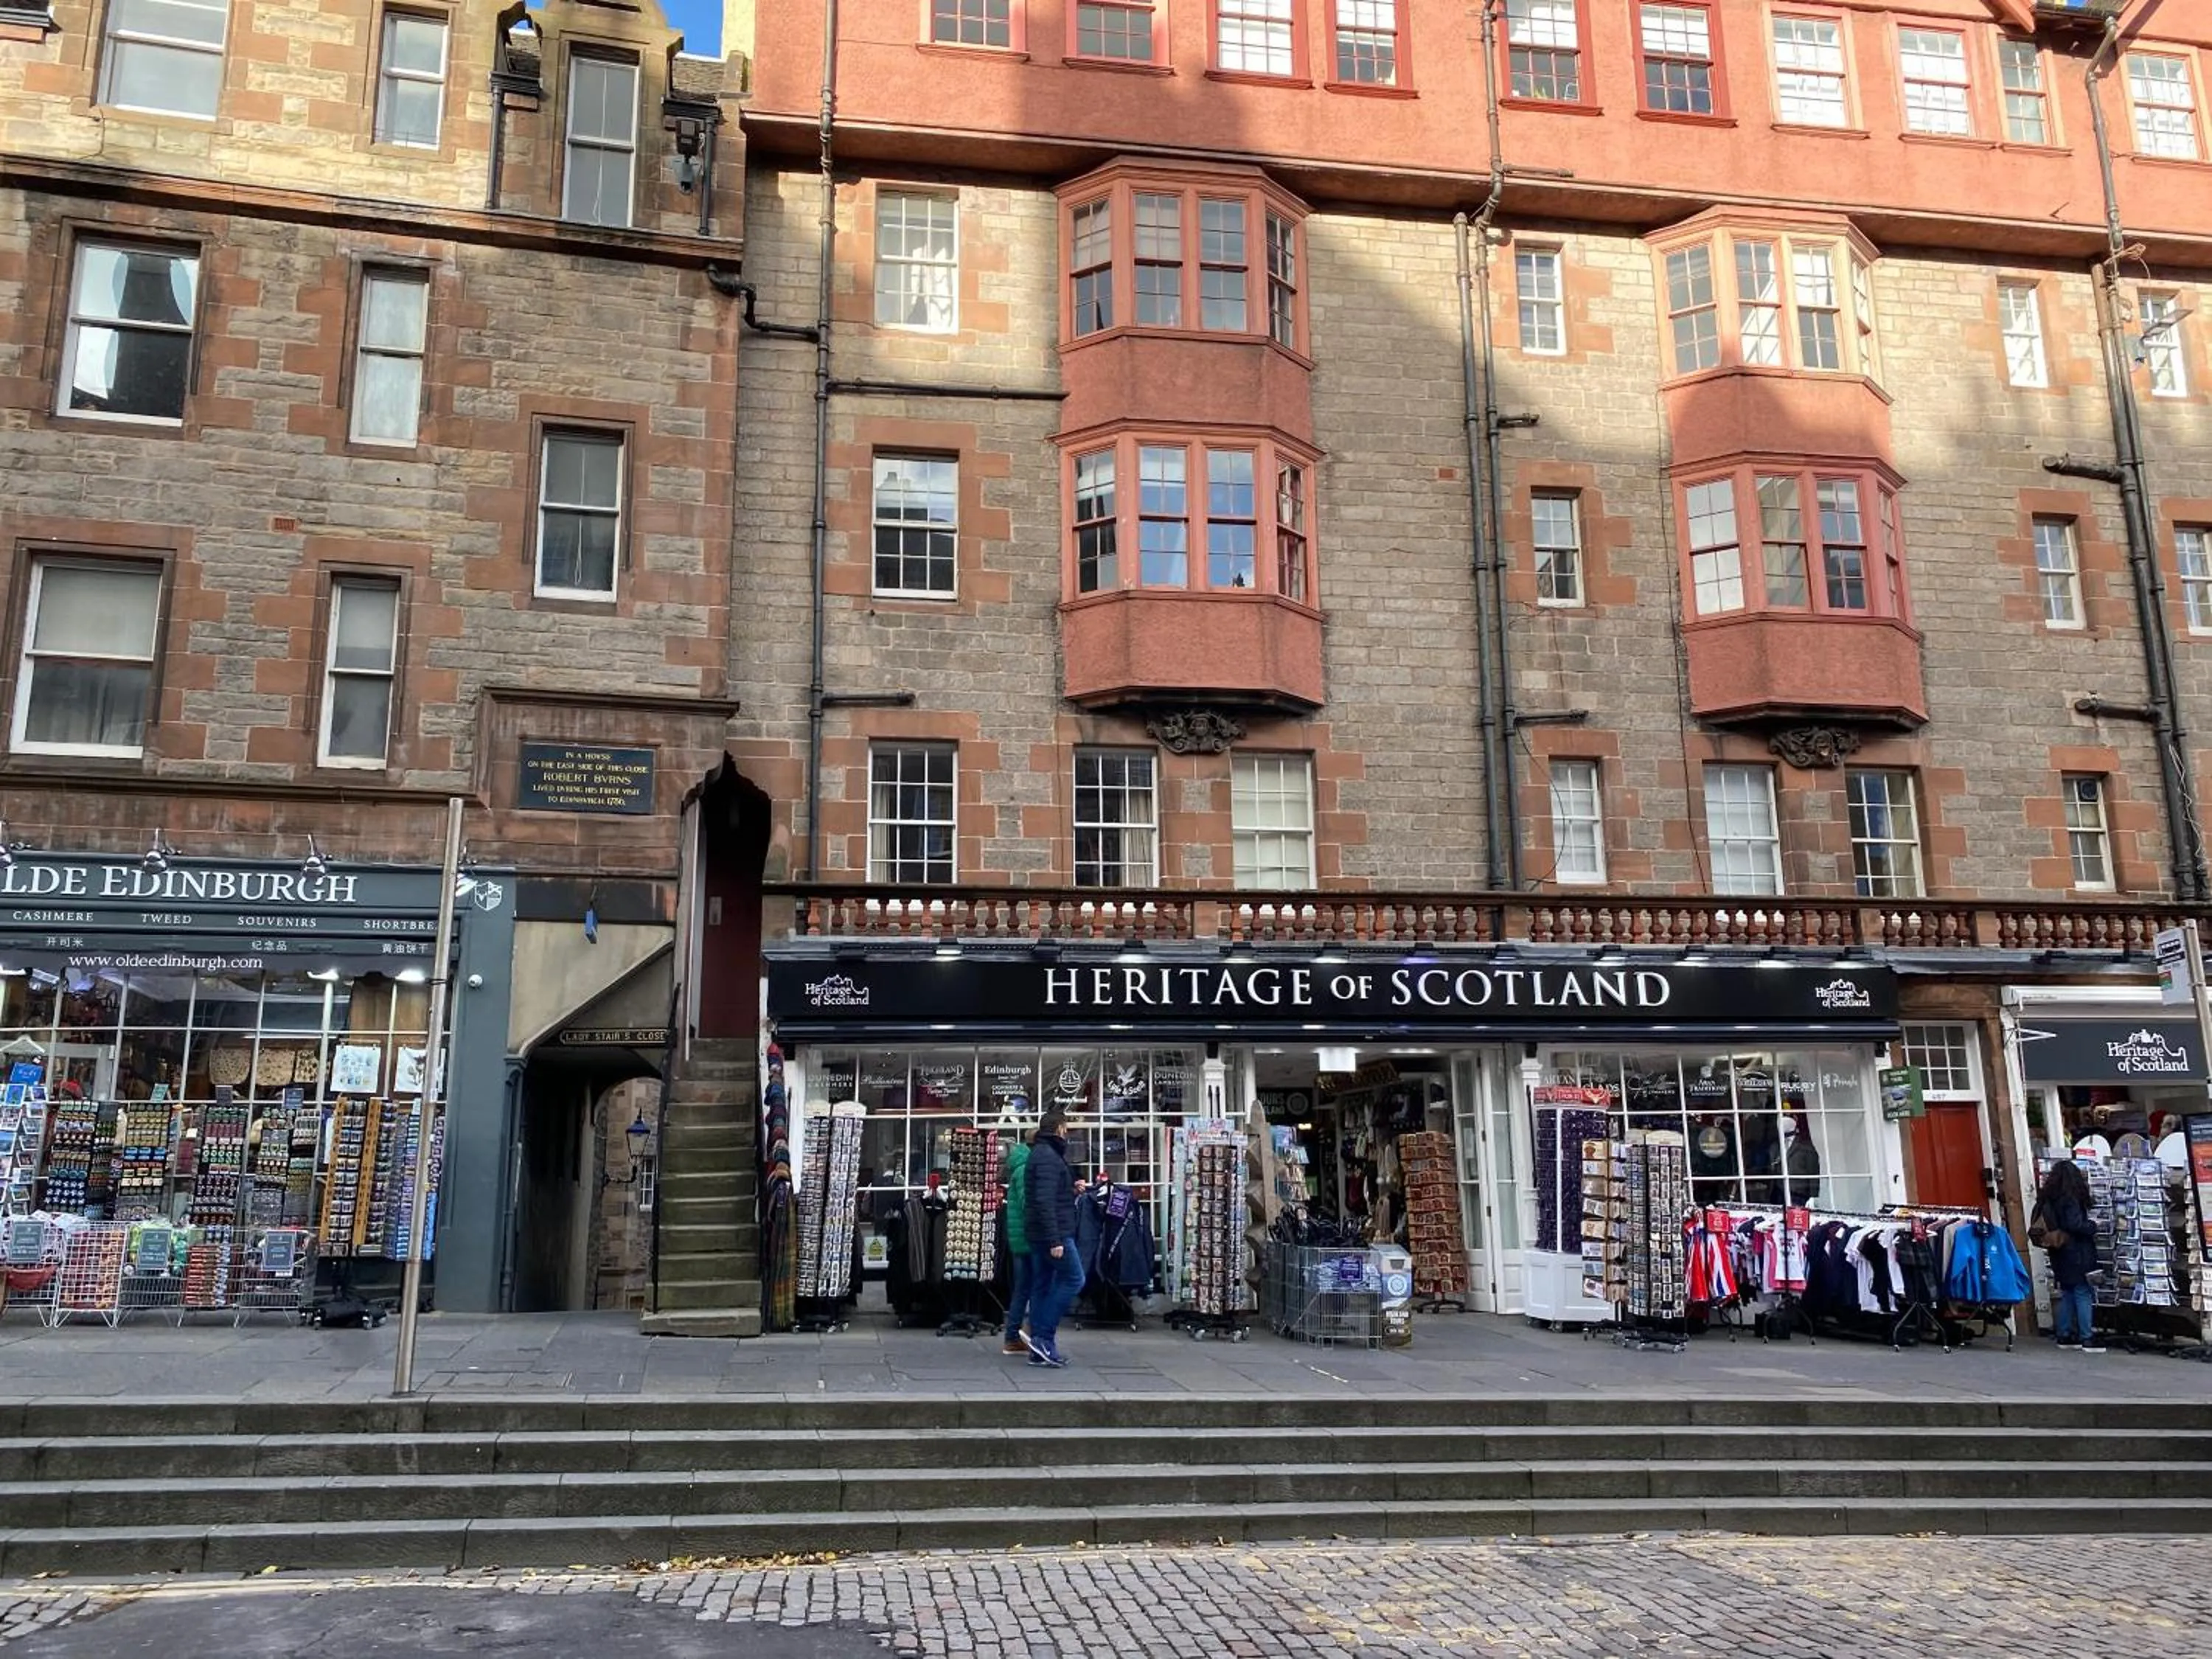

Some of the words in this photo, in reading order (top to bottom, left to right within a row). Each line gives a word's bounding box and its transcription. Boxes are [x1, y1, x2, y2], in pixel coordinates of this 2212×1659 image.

[527, 760, 538, 768] ON
[540, 761, 554, 770] THE
[557, 762, 574, 770] EAST
[577, 763, 593, 771] SIDE
[608, 765, 623, 773] THIS
[543, 772, 588, 783] ROBERT
[594, 775, 632, 785] BVRNS
[533, 784, 555, 793] LIVED
[599, 787, 620, 795] FIRST
[622, 788, 641, 796] VISIT
[99, 866, 358, 902] EDINBURGH
[13, 911, 94, 922] CASHMERE
[141, 913, 192, 925] TWEED
[237, 916, 317, 928] SOUVENIRS
[364, 919, 438, 931] SHORTBRE
[46, 936, 83, 947] 开司米
[251, 940, 288, 951] 纪念品
[382, 943, 428, 954] 黄油饼干
[69, 954, 262, 971] www.oldeedinburgh.com
[804, 983, 852, 998] Heritage
[1044, 967, 1312, 1005] HERITAGE
[1330, 975, 1372, 999] OF
[1391, 970, 1670, 1006] SCOTLAND
[811, 995, 821, 1006] of
[823, 993, 869, 1006] Scotland
[1815, 987, 1854, 1001] Heritage
[1821, 997, 1831, 1009] of
[1832, 995, 1870, 1007] Scotland
[566, 1032, 589, 1040] LADY
[636, 1032, 666, 1040] CLOSE
[2107, 1042, 2164, 1060] Heritage
[984, 1065, 1032, 1075] Edinburgh
[2117, 1057, 2130, 1074] of
[2132, 1055, 2189, 1071] Scotland
[807, 1073, 853, 1082] DUNEDIN
[1781, 1082, 1816, 1090] RUGBY
